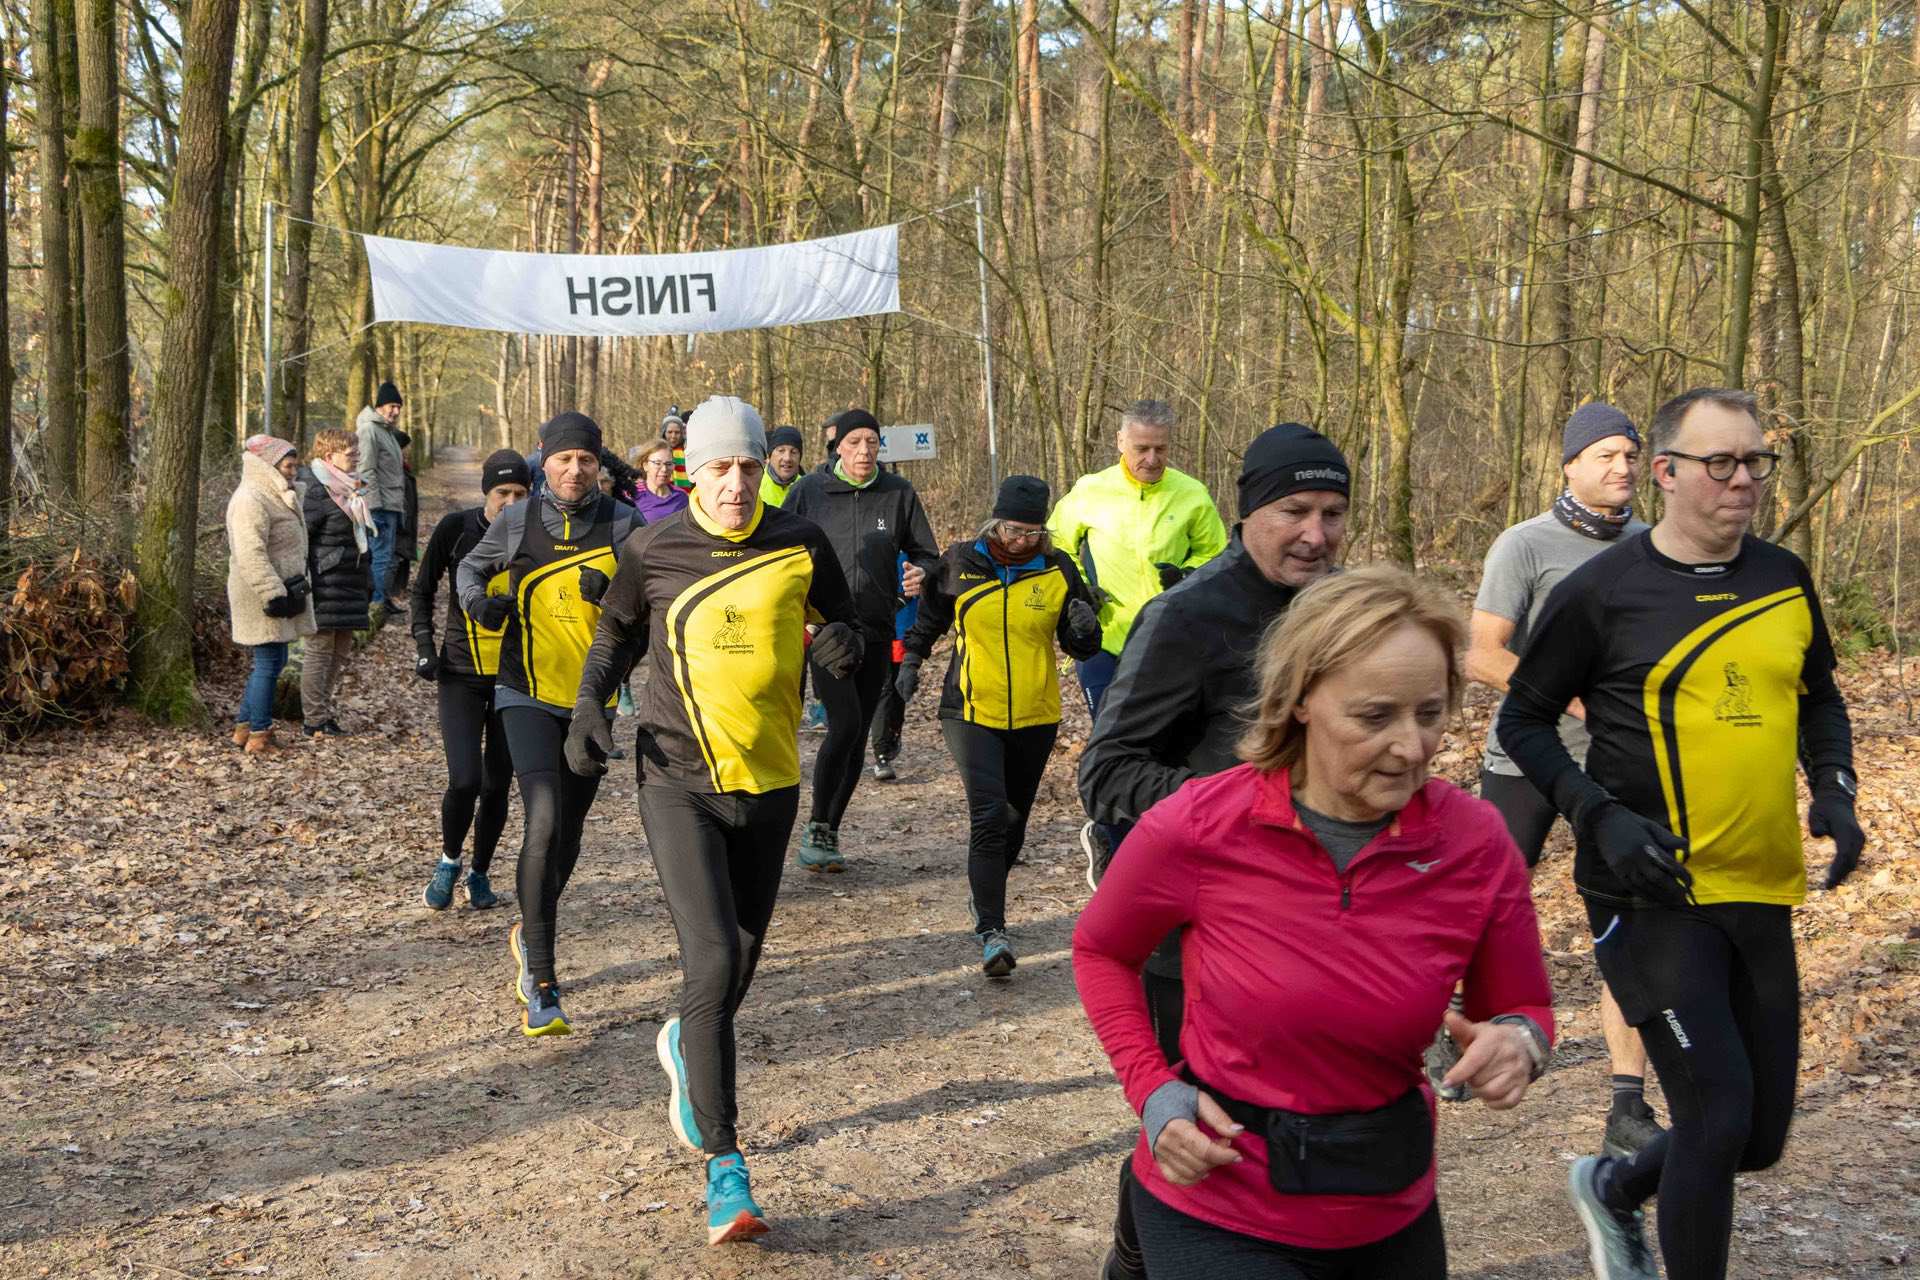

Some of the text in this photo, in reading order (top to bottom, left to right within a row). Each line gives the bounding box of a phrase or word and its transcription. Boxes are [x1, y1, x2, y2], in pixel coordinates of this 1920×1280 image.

[1294, 467, 1348, 484] newline
[1695, 594, 1729, 602] CRAFT
[1661, 1008, 1693, 1049] FUSION
